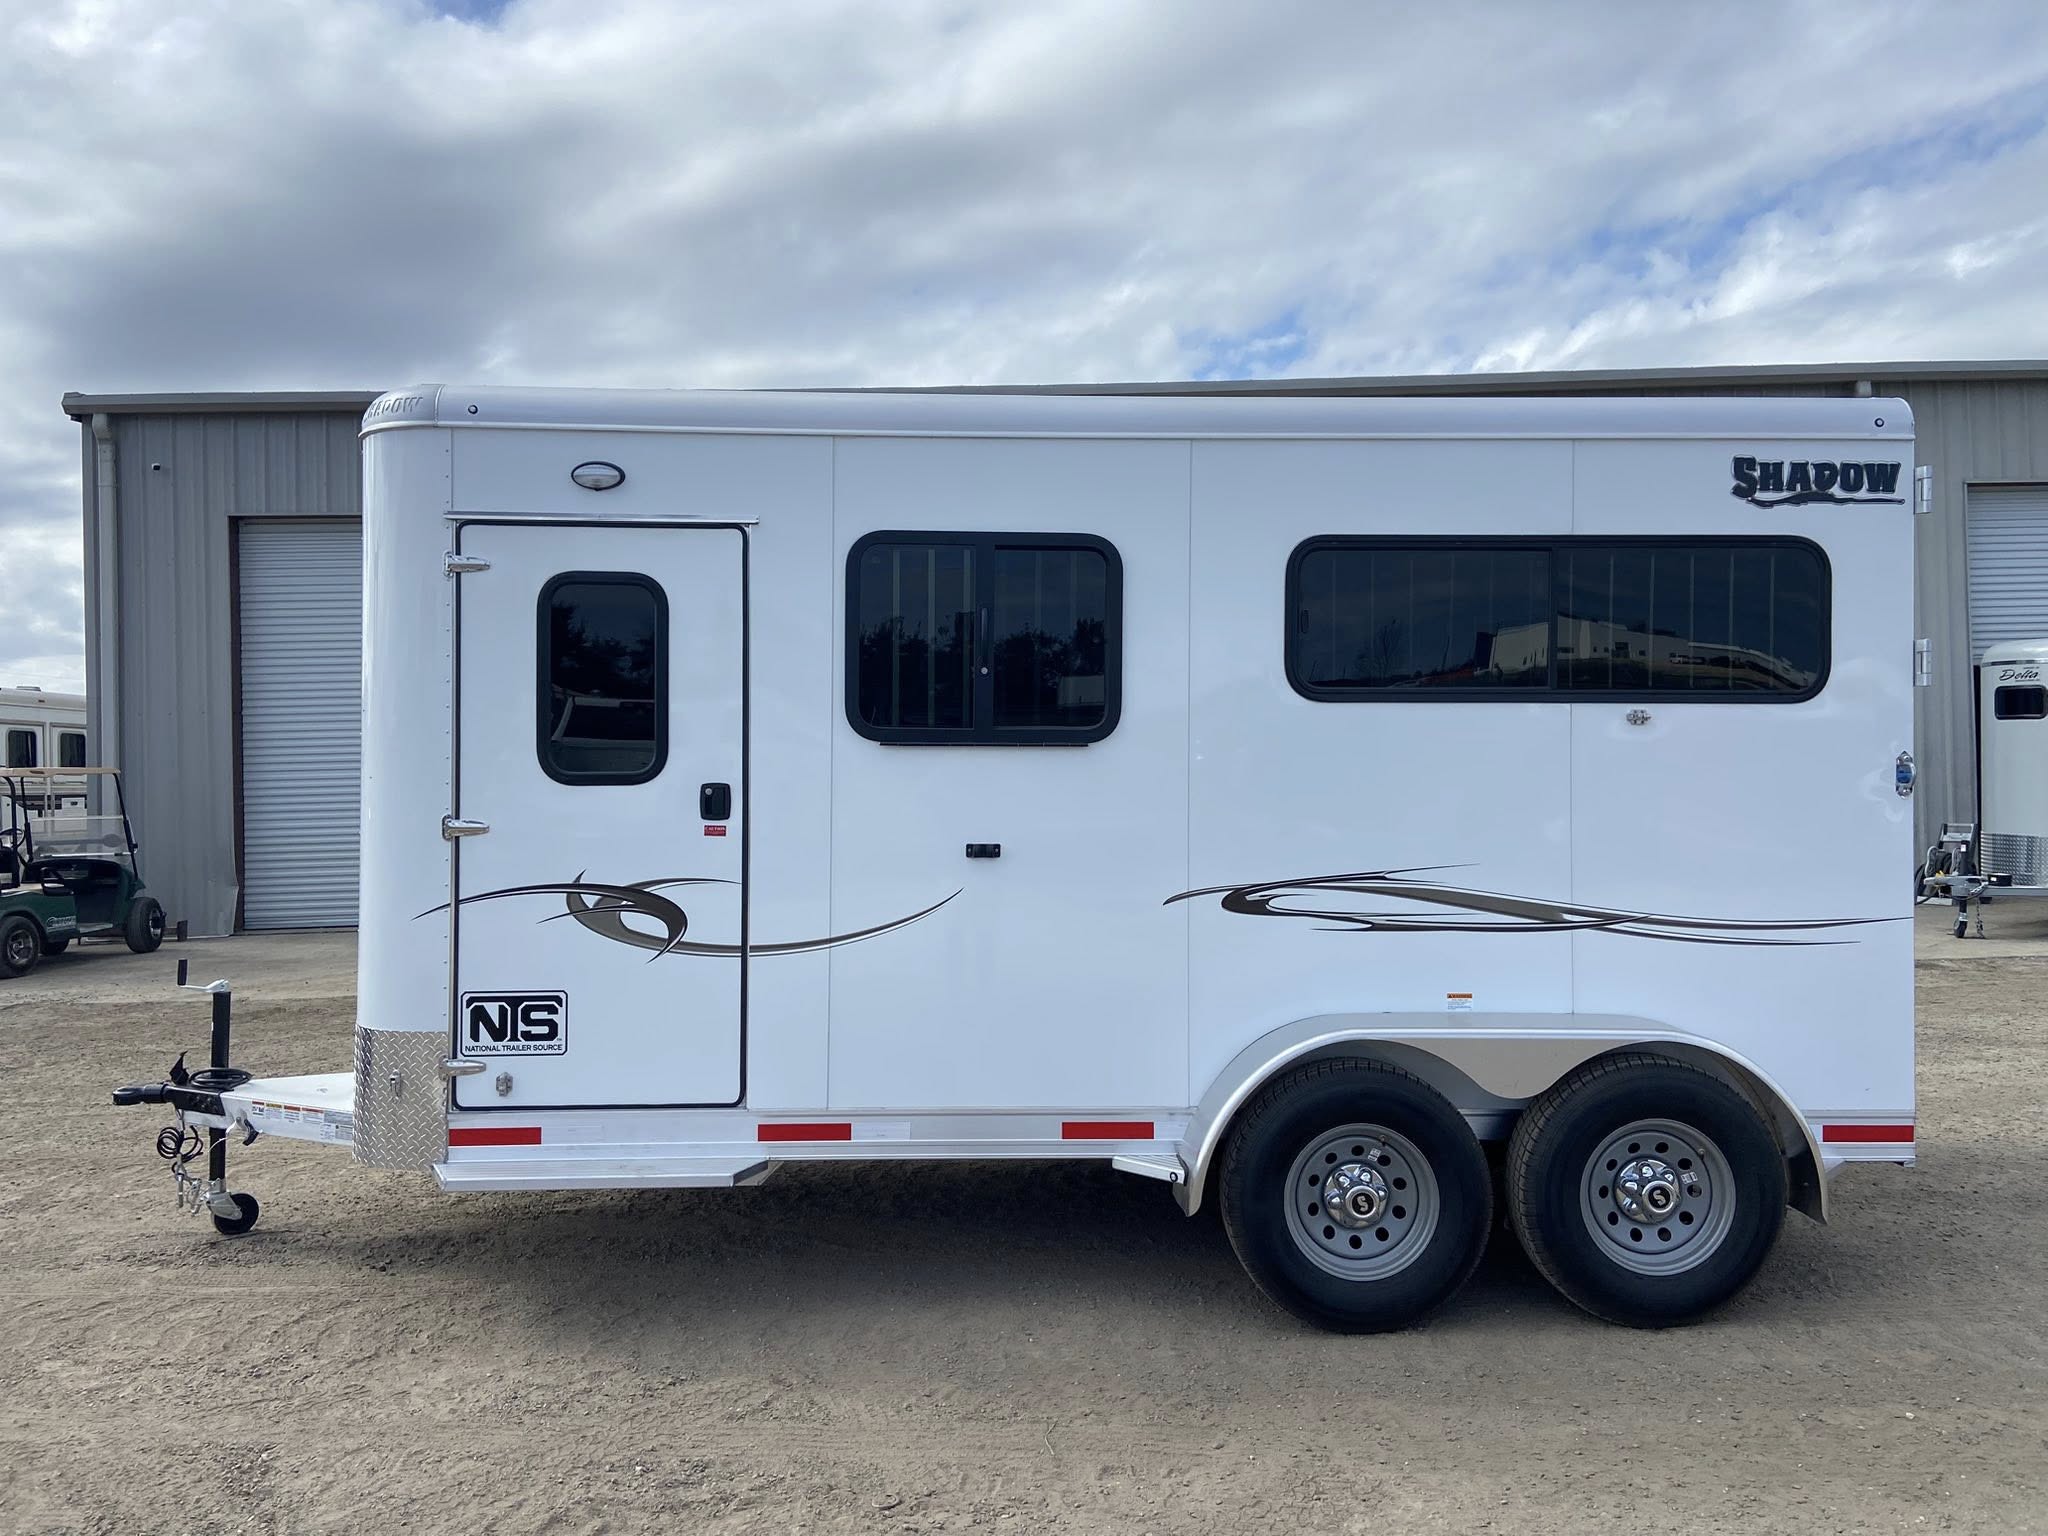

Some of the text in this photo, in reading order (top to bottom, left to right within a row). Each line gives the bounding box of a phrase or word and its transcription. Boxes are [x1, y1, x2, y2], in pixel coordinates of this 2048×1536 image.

[1731, 455, 1901, 499] SHADOW
[1999, 669, 2039, 681] Delta
[466, 995, 563, 1042] NTS
[502, 1044, 532, 1052] TRAILER
[533, 1043, 563, 1051] SOURCE
